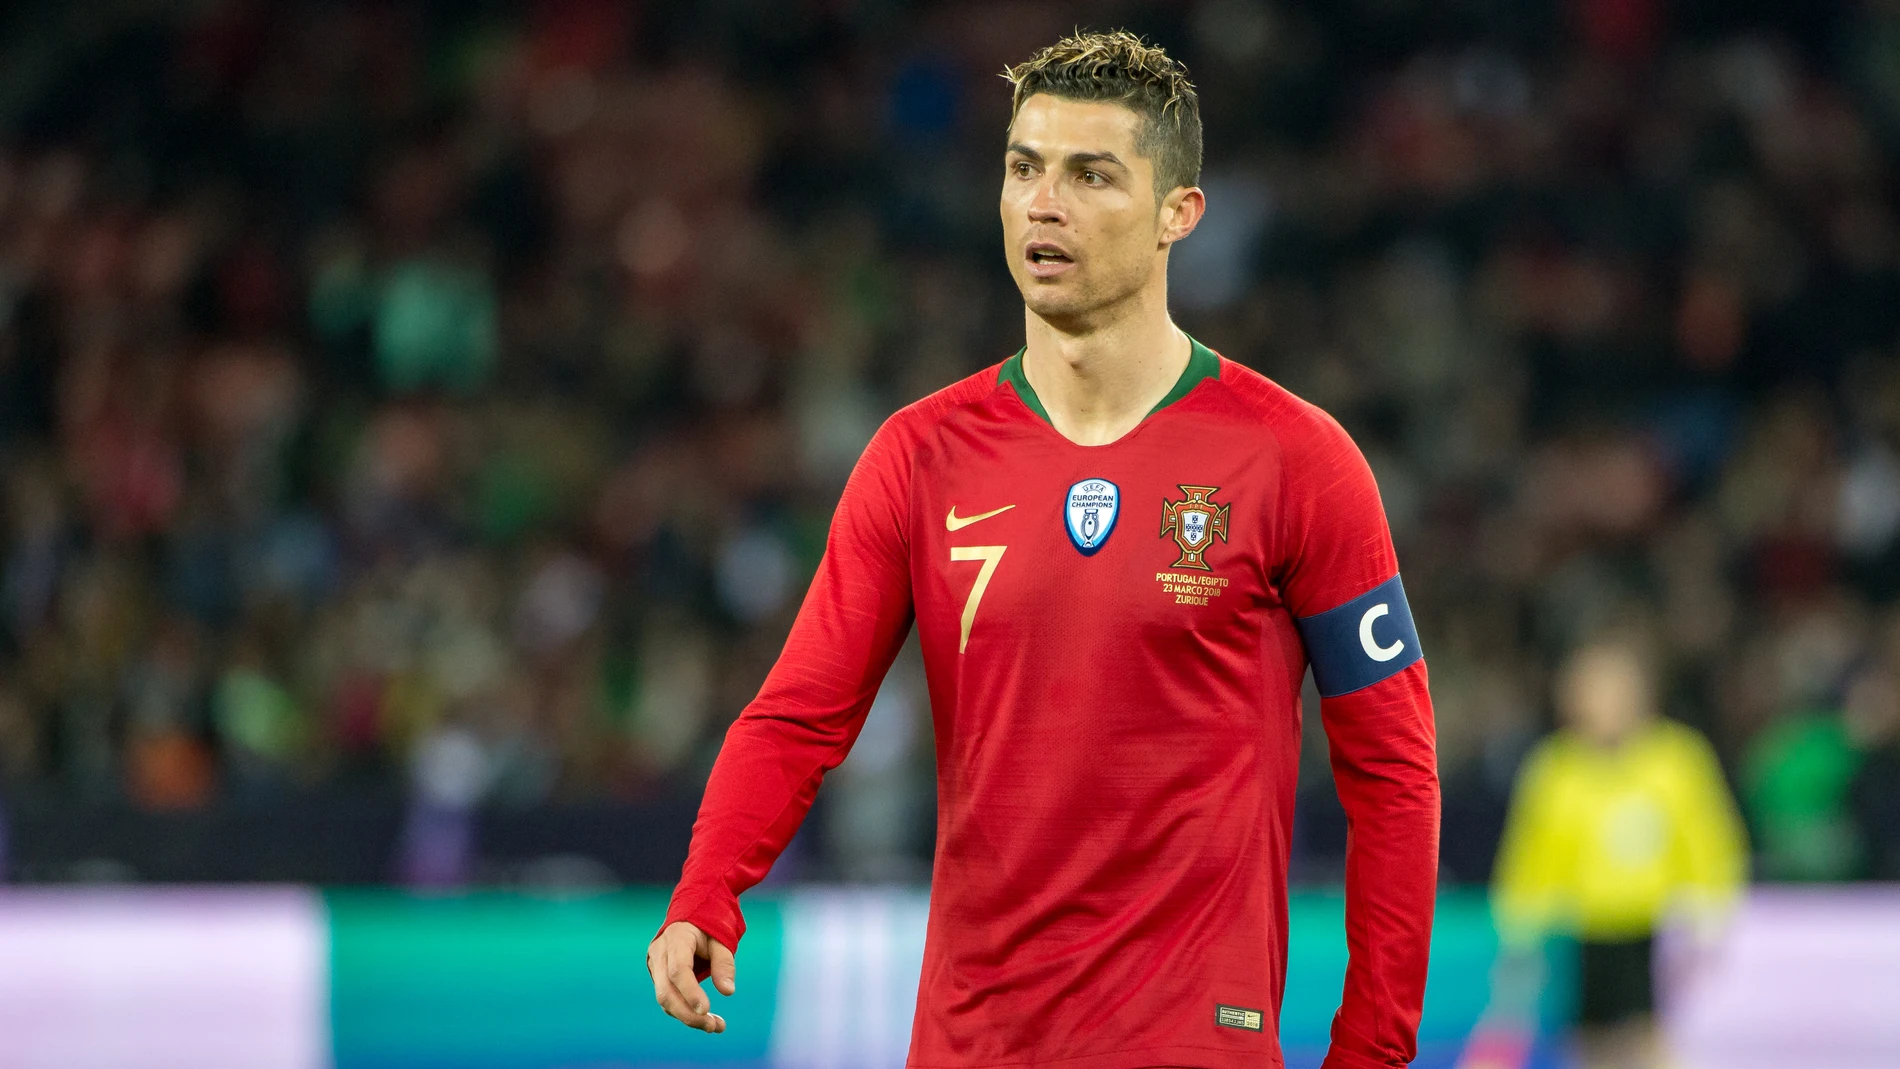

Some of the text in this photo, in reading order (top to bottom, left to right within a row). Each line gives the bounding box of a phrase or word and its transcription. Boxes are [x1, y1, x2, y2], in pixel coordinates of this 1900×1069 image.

[1083, 484, 1104, 492] UEFA
[1072, 494, 1114, 502] EUROPEAN
[1155, 572, 1229, 588] PORTUGAL/EGIPTO
[1163, 583, 1173, 593] 23
[1203, 587, 1221, 597] 2018
[950, 545, 1008, 655] 7
[1175, 594, 1209, 606] ZURIQUE
[1359, 603, 1405, 662] C
